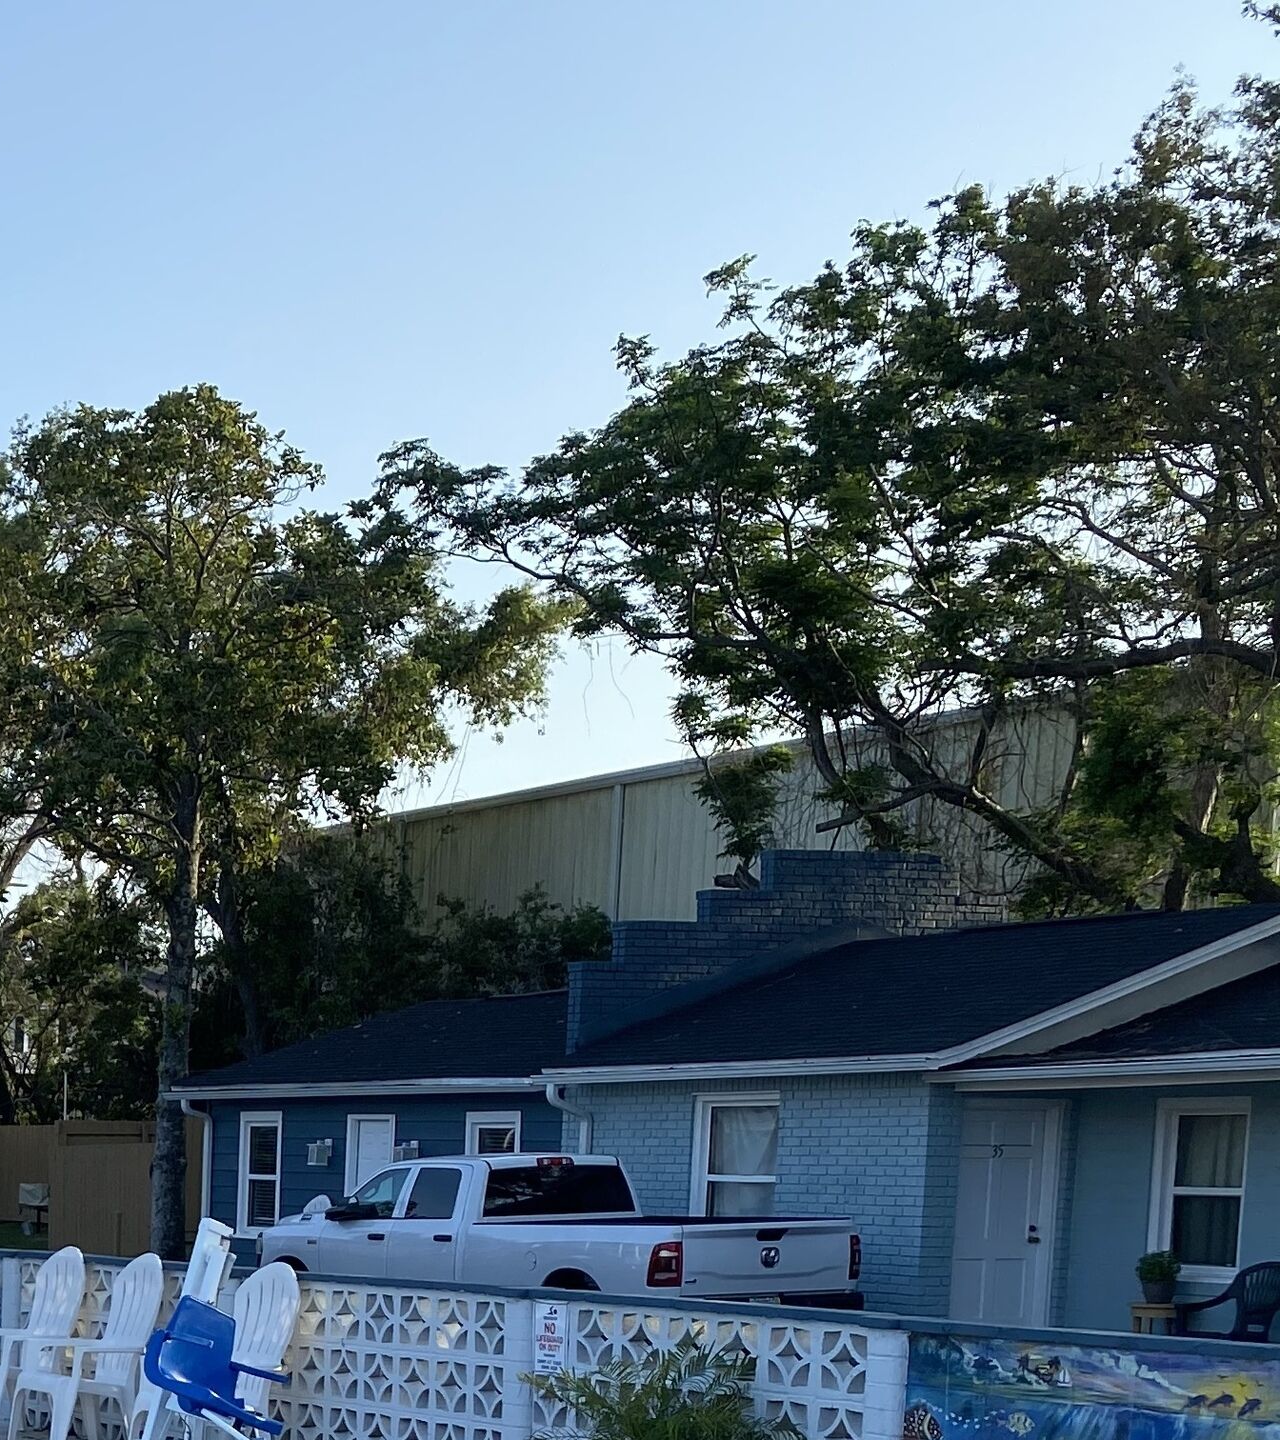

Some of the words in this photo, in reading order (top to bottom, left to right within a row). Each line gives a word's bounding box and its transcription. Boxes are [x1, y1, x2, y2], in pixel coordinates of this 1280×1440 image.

[992, 1144, 1005, 1158] 35
[544, 1322, 556, 1335] NO
[539, 1343, 546, 1351] ON
